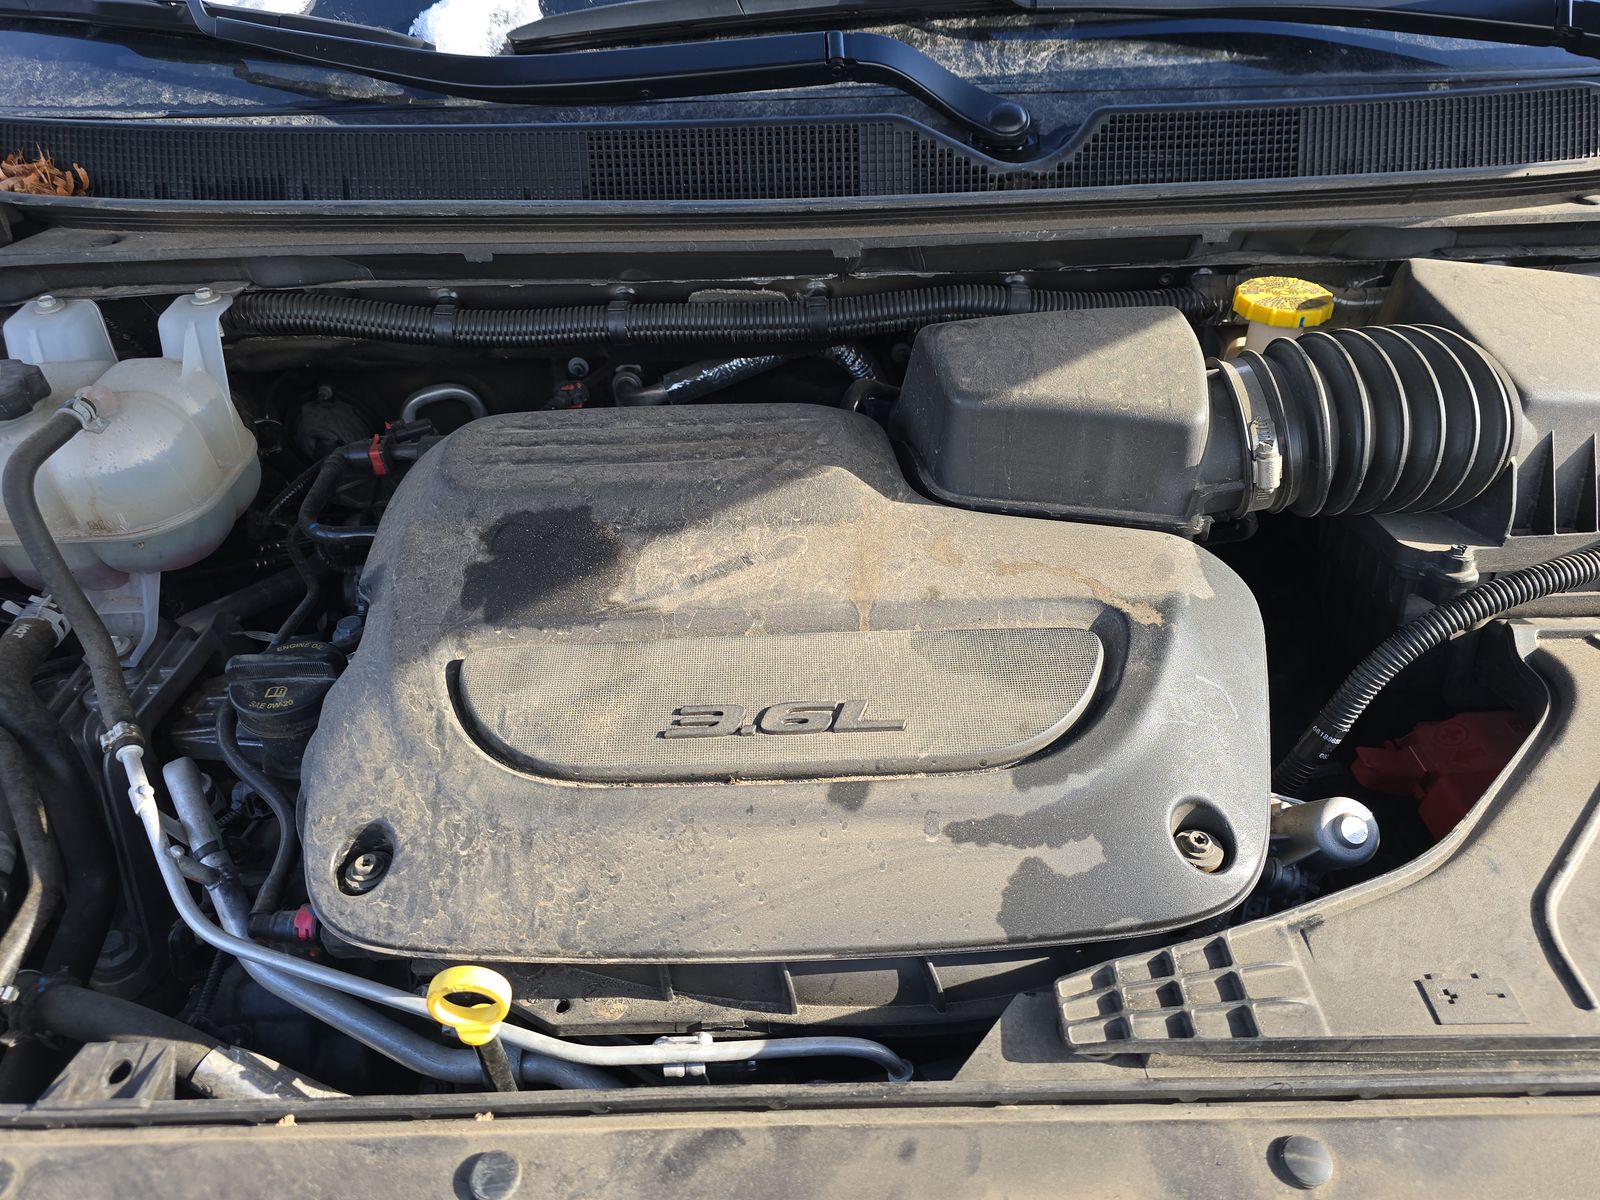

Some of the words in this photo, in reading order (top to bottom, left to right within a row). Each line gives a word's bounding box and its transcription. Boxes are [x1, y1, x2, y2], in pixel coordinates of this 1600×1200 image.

[12, 623, 32, 639] HOT
[276, 642, 311, 652] ENGINE
[248, 700, 266, 709] SAE
[266, 699, 294, 709] 0W-20
[662, 698, 907, 739] 3.6L
